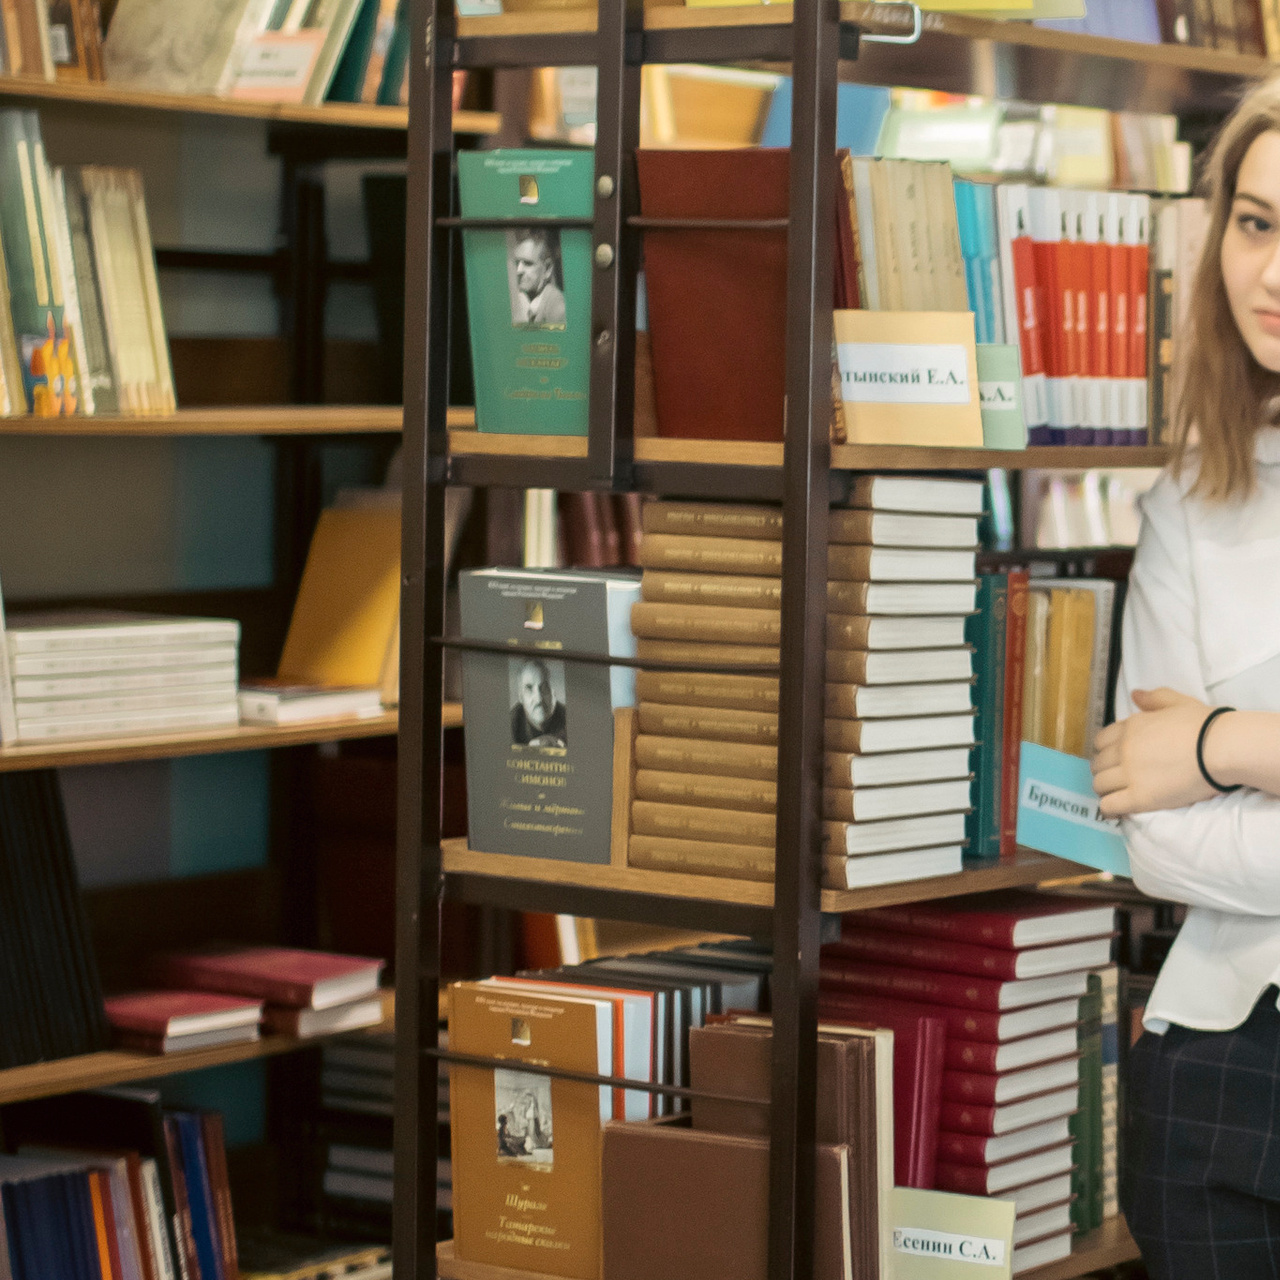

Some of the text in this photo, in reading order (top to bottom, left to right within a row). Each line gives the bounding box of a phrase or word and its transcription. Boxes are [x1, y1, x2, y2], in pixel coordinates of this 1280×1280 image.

[840, 368, 921, 384] тынский
[1028, 785, 1090, 818] Брюсов
[892, 1230, 997, 1261] Есенин С.А.
